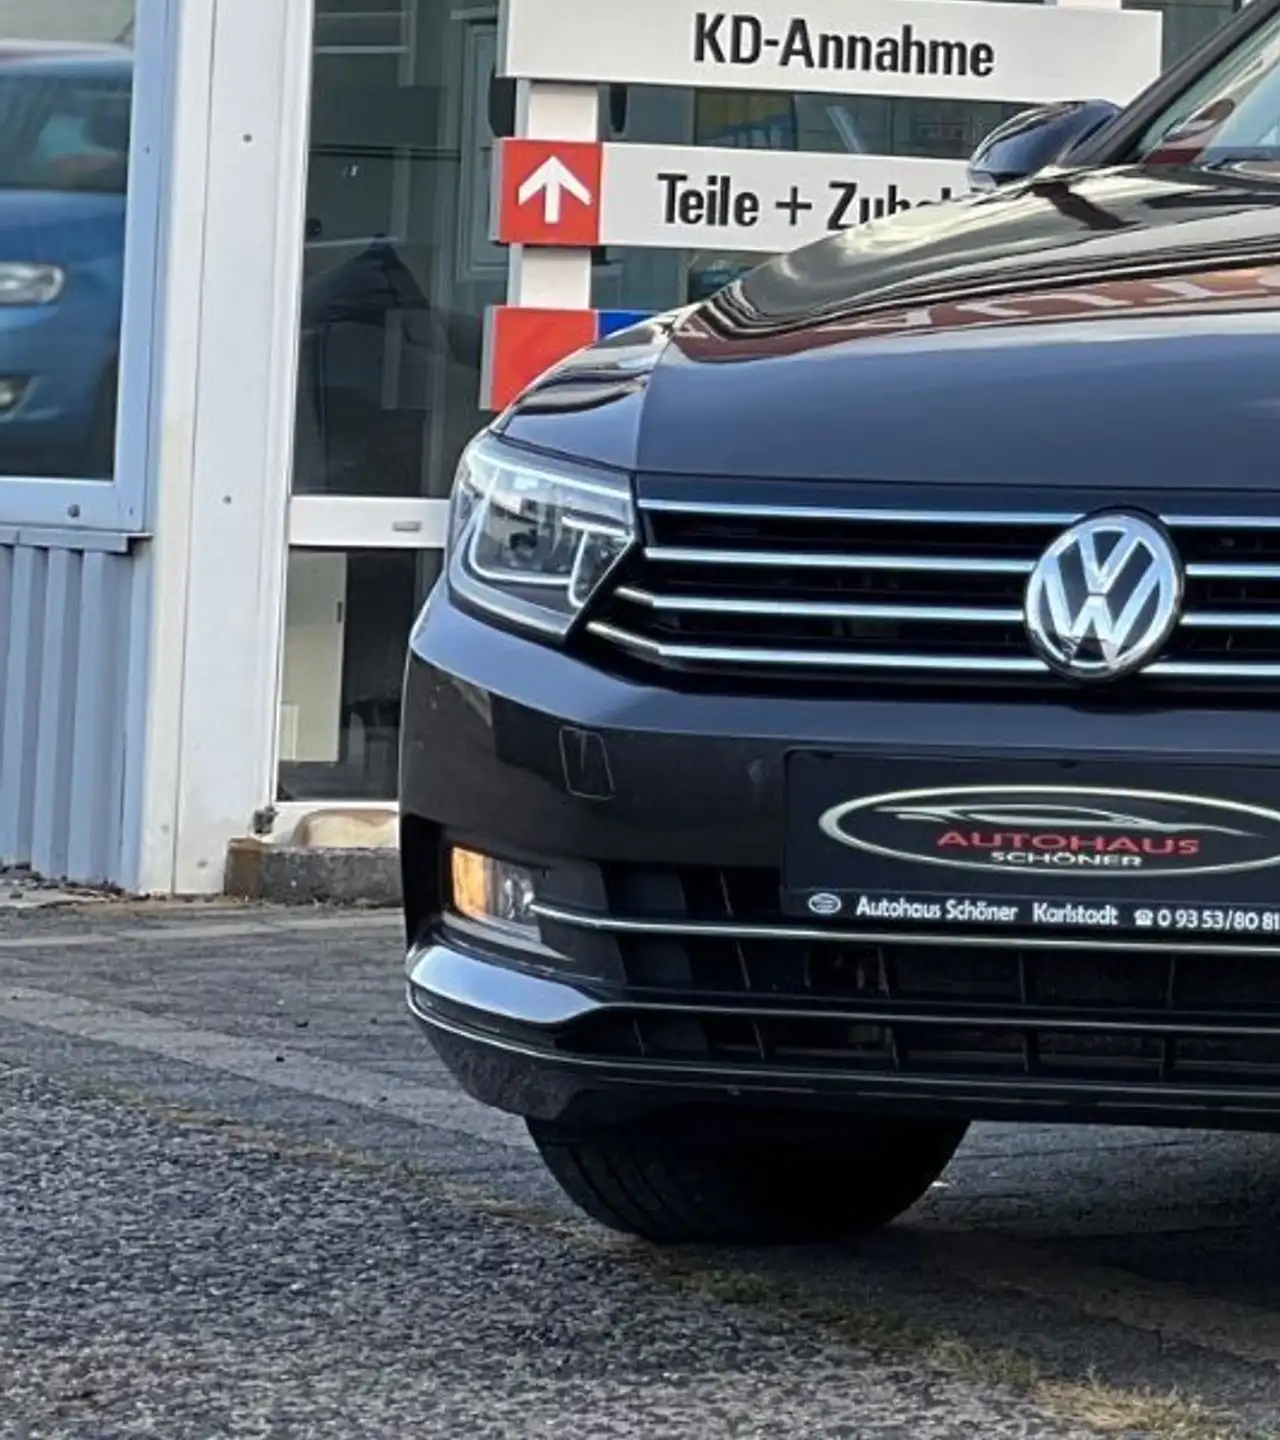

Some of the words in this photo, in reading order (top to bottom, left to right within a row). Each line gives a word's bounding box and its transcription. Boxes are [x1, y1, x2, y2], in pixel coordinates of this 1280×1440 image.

[694, 12, 995, 77] KD-Annahme
[657, 173, 759, 226] Teile
[776, 186, 812, 225] +
[1027, 517, 1178, 670] VW
[937, 830, 1200, 855] AUTOHAUS
[990, 850, 1143, 868] SCHÖNER
[856, 895, 940, 919] Autohaus
[945, 898, 1019, 922] Schöner
[1032, 902, 1119, 926] Karlstadt
[1157, 909, 1172, 928] 0
